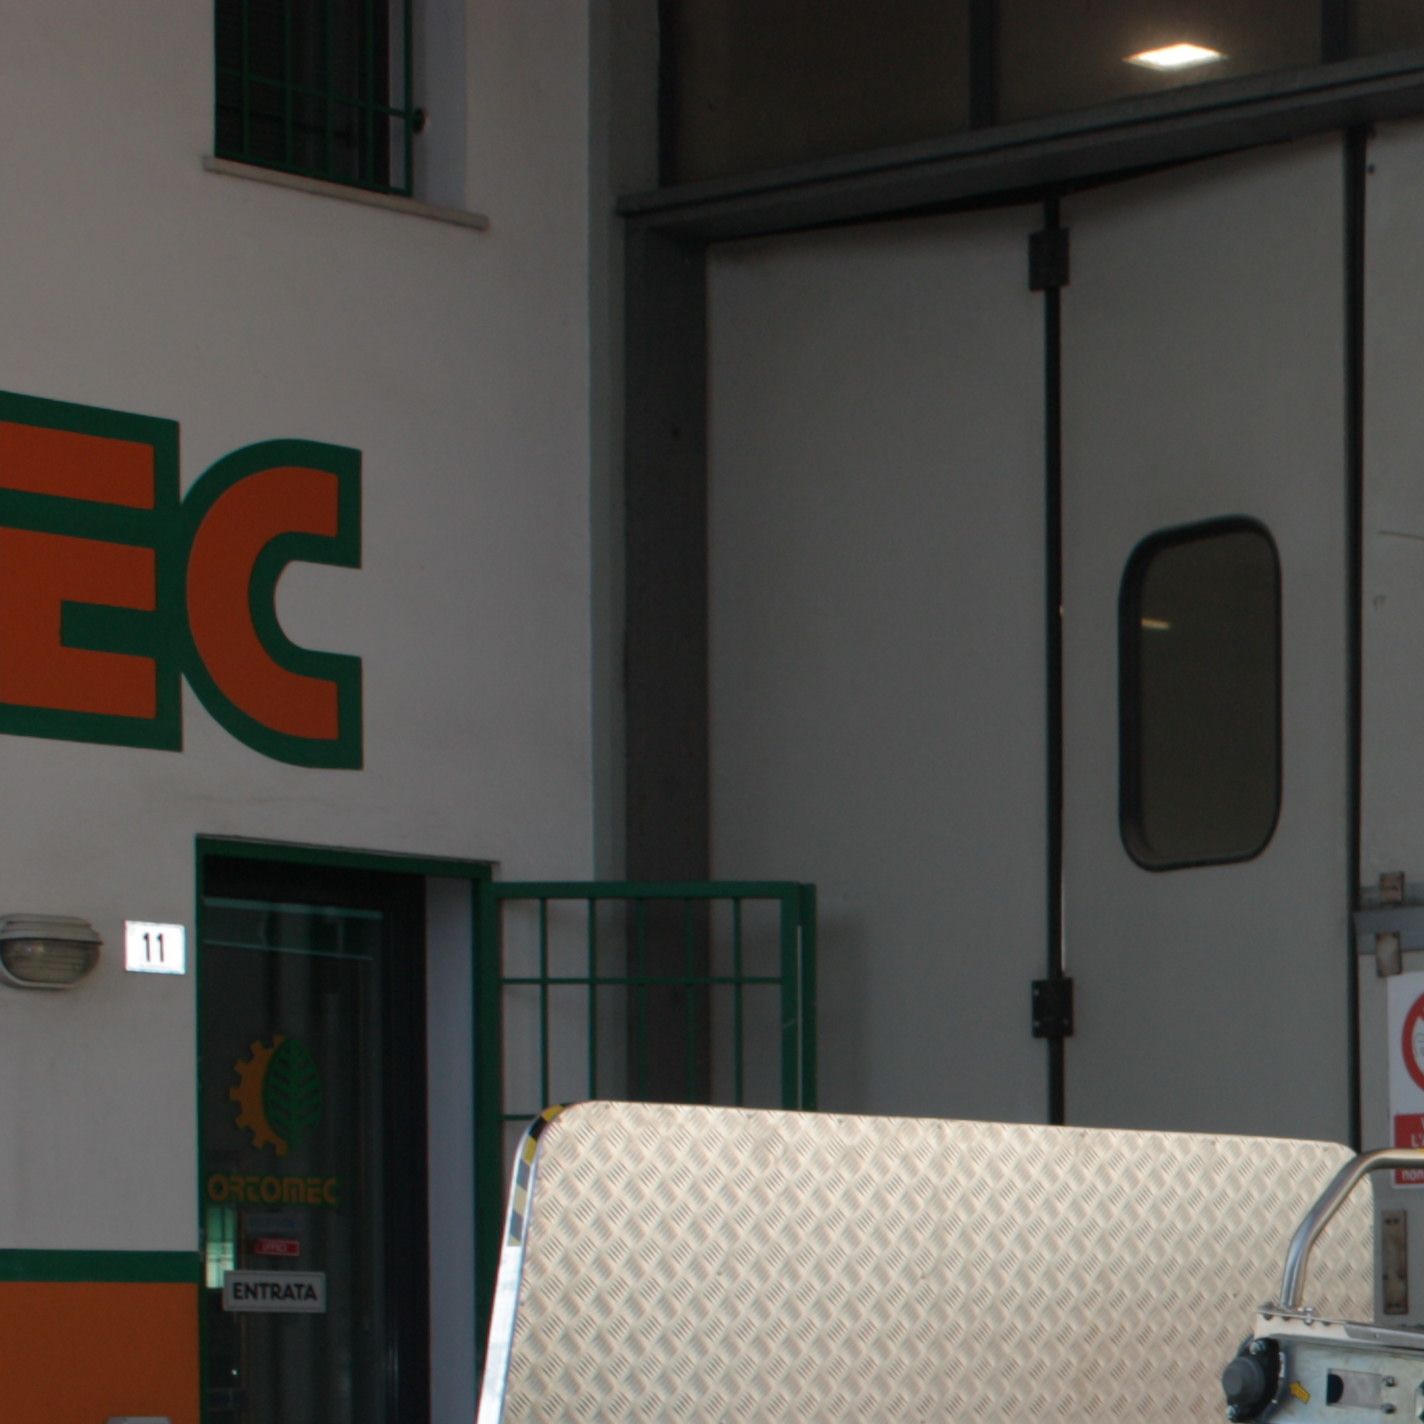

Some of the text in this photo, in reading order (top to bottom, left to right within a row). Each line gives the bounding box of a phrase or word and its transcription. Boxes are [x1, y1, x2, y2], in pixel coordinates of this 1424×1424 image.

[142, 932, 166, 964] 11
[206, 1174, 337, 1204] ORTOMEC
[232, 1281, 317, 1301] ENTRATA
